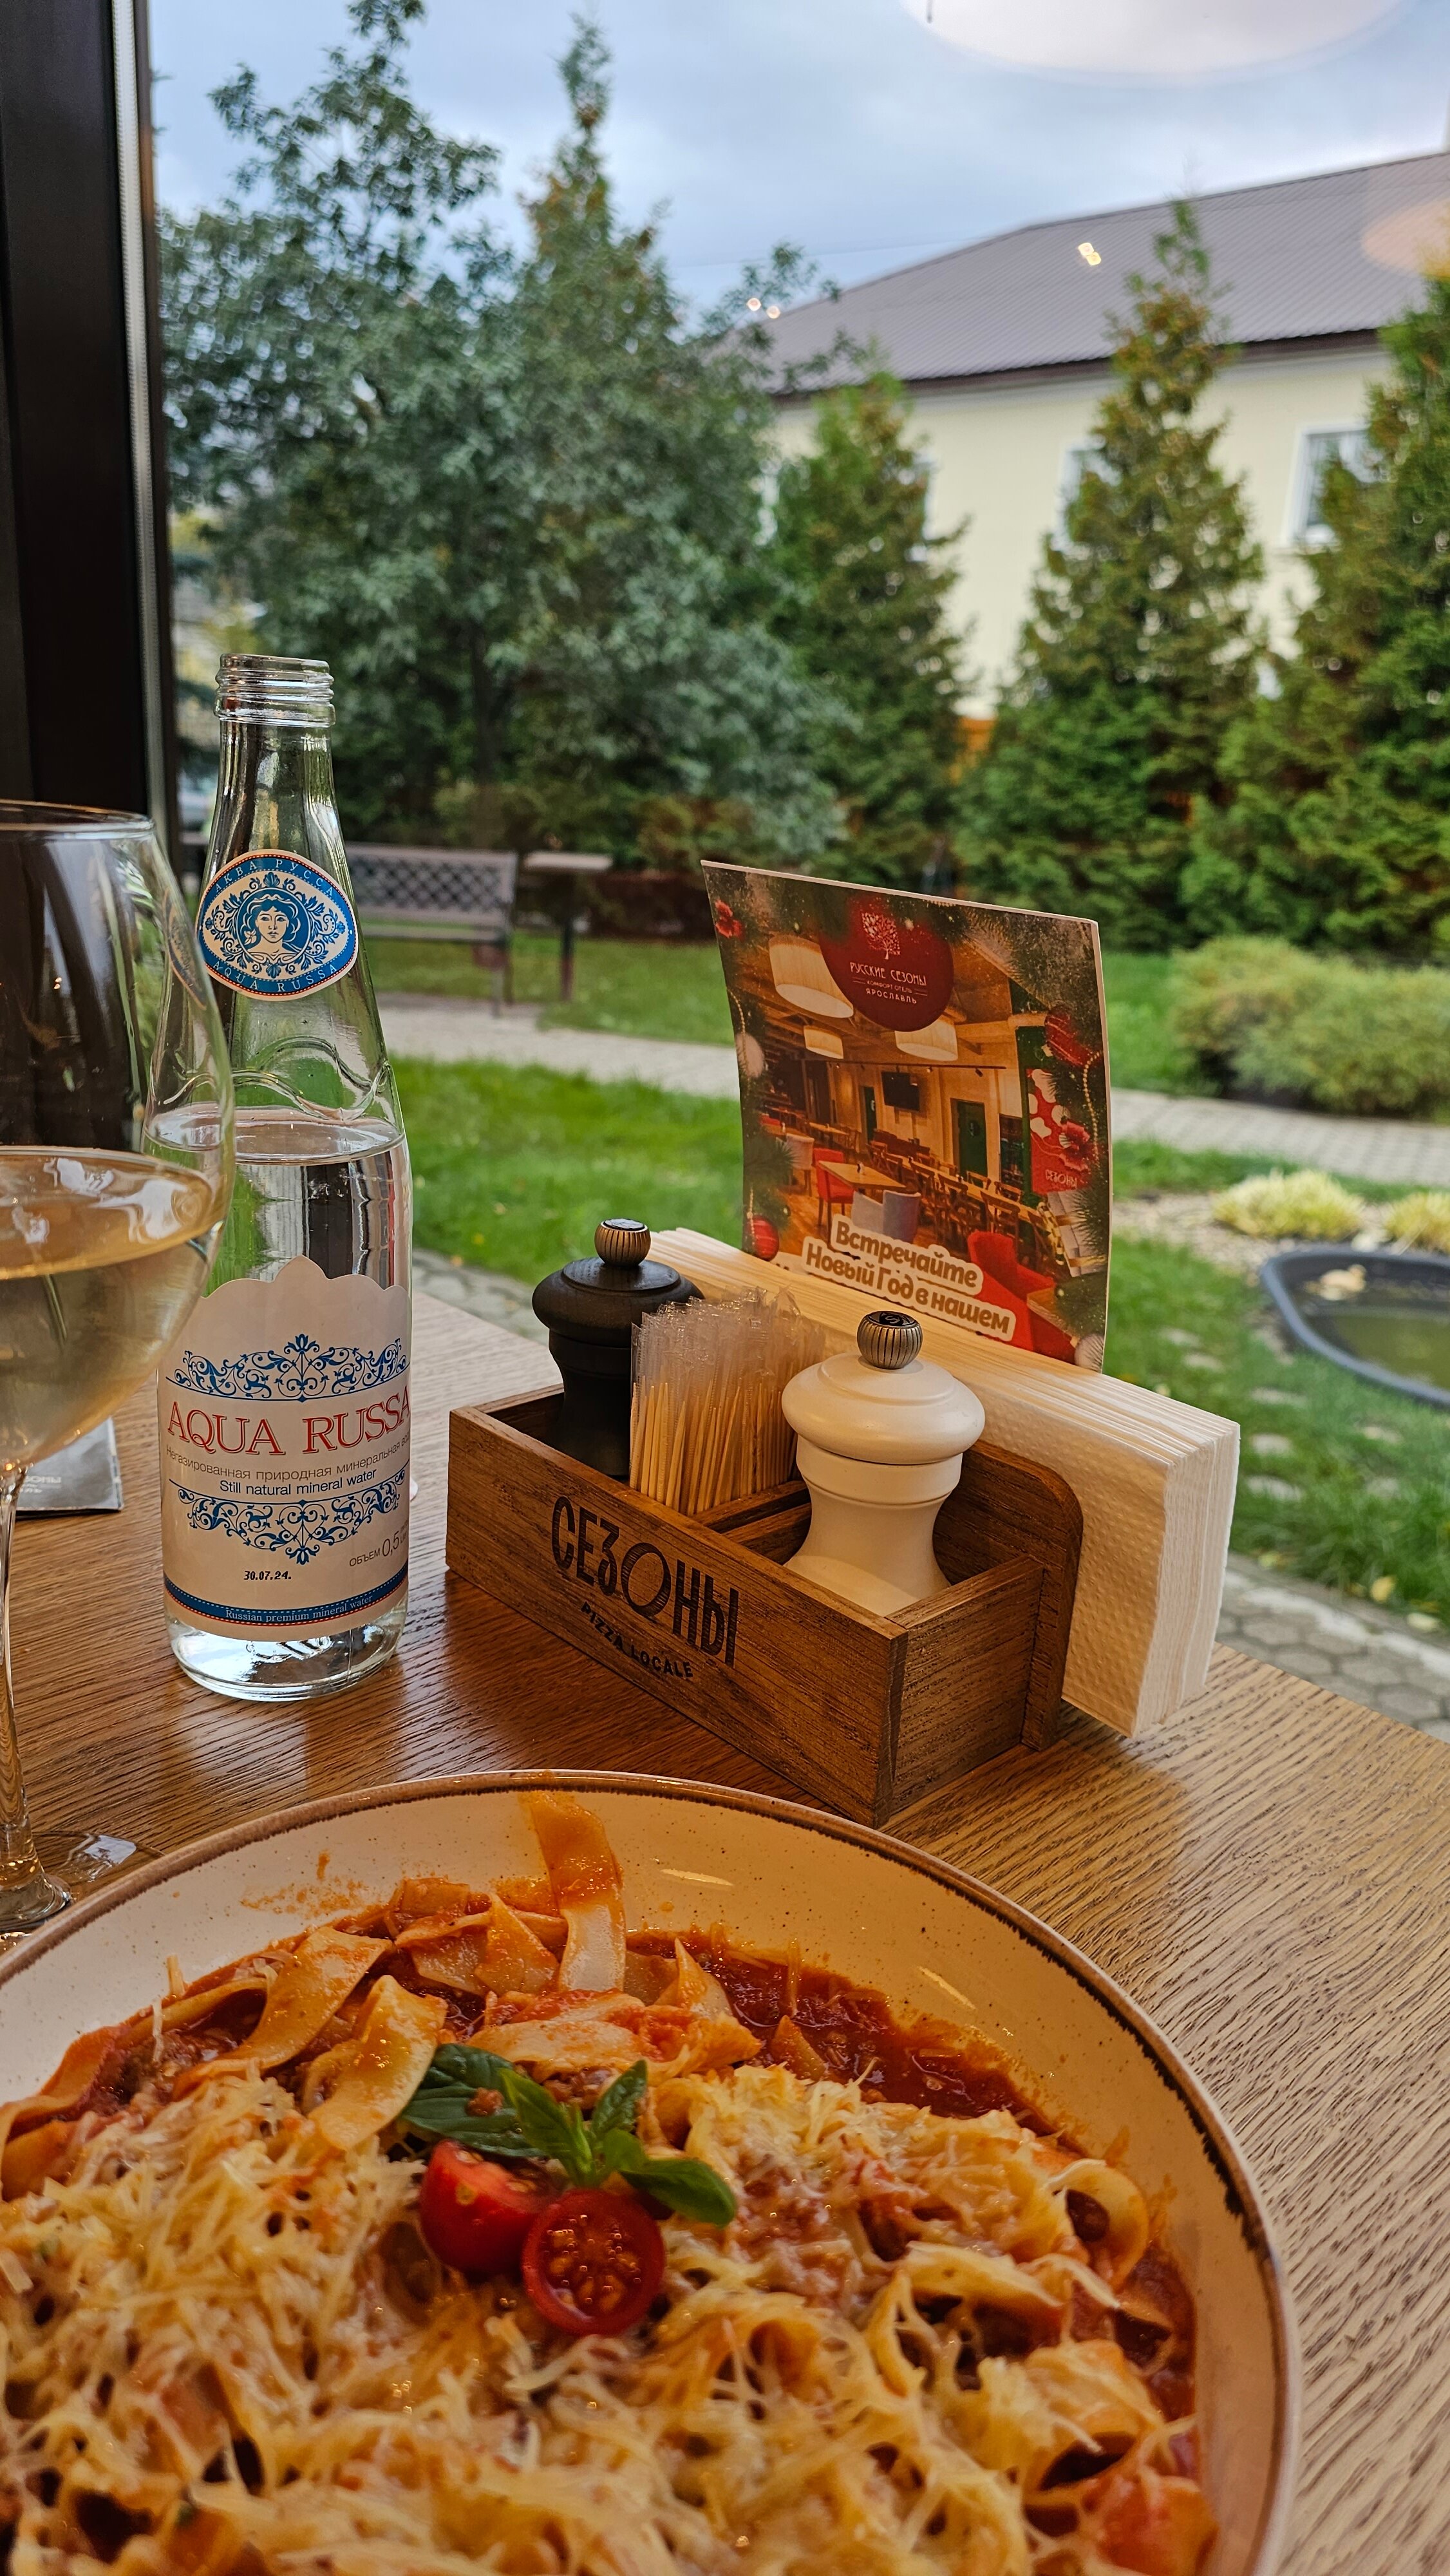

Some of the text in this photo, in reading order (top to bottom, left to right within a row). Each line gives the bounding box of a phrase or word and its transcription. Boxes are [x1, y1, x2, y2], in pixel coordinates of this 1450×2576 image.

[215, 859, 333, 896] АКВА РУССА
[212, 960, 337, 992] AQUA RUSSA
[850, 961, 927, 986] РУССКИЕ СЕЗОНЫ
[865, 988, 917, 1004] ЯРОСЛАВЛЬ
[836, 1221, 978, 1288] Встречайте
[805, 1243, 1011, 1334] Новый Год в нашем
[167, 1385, 410, 1455] AQUA RUSSA
[166, 1444, 250, 1480] Негазированная
[256, 1467, 332, 1482] природная
[336, 1442, 400, 1474] минеральная
[220, 1468, 377, 1495] Still natural mineral water
[349, 1548, 381, 1567] ОБЪЕМ
[382, 1530, 399, 1557] 0,5
[243, 1570, 292, 1581] 30.07.24.
[552, 1495, 740, 1669] СЕЗОНЫ
[225, 1594, 373, 1623] Russian premium mineral water
[581, 1601, 693, 1678] PIZZA LOCALE
